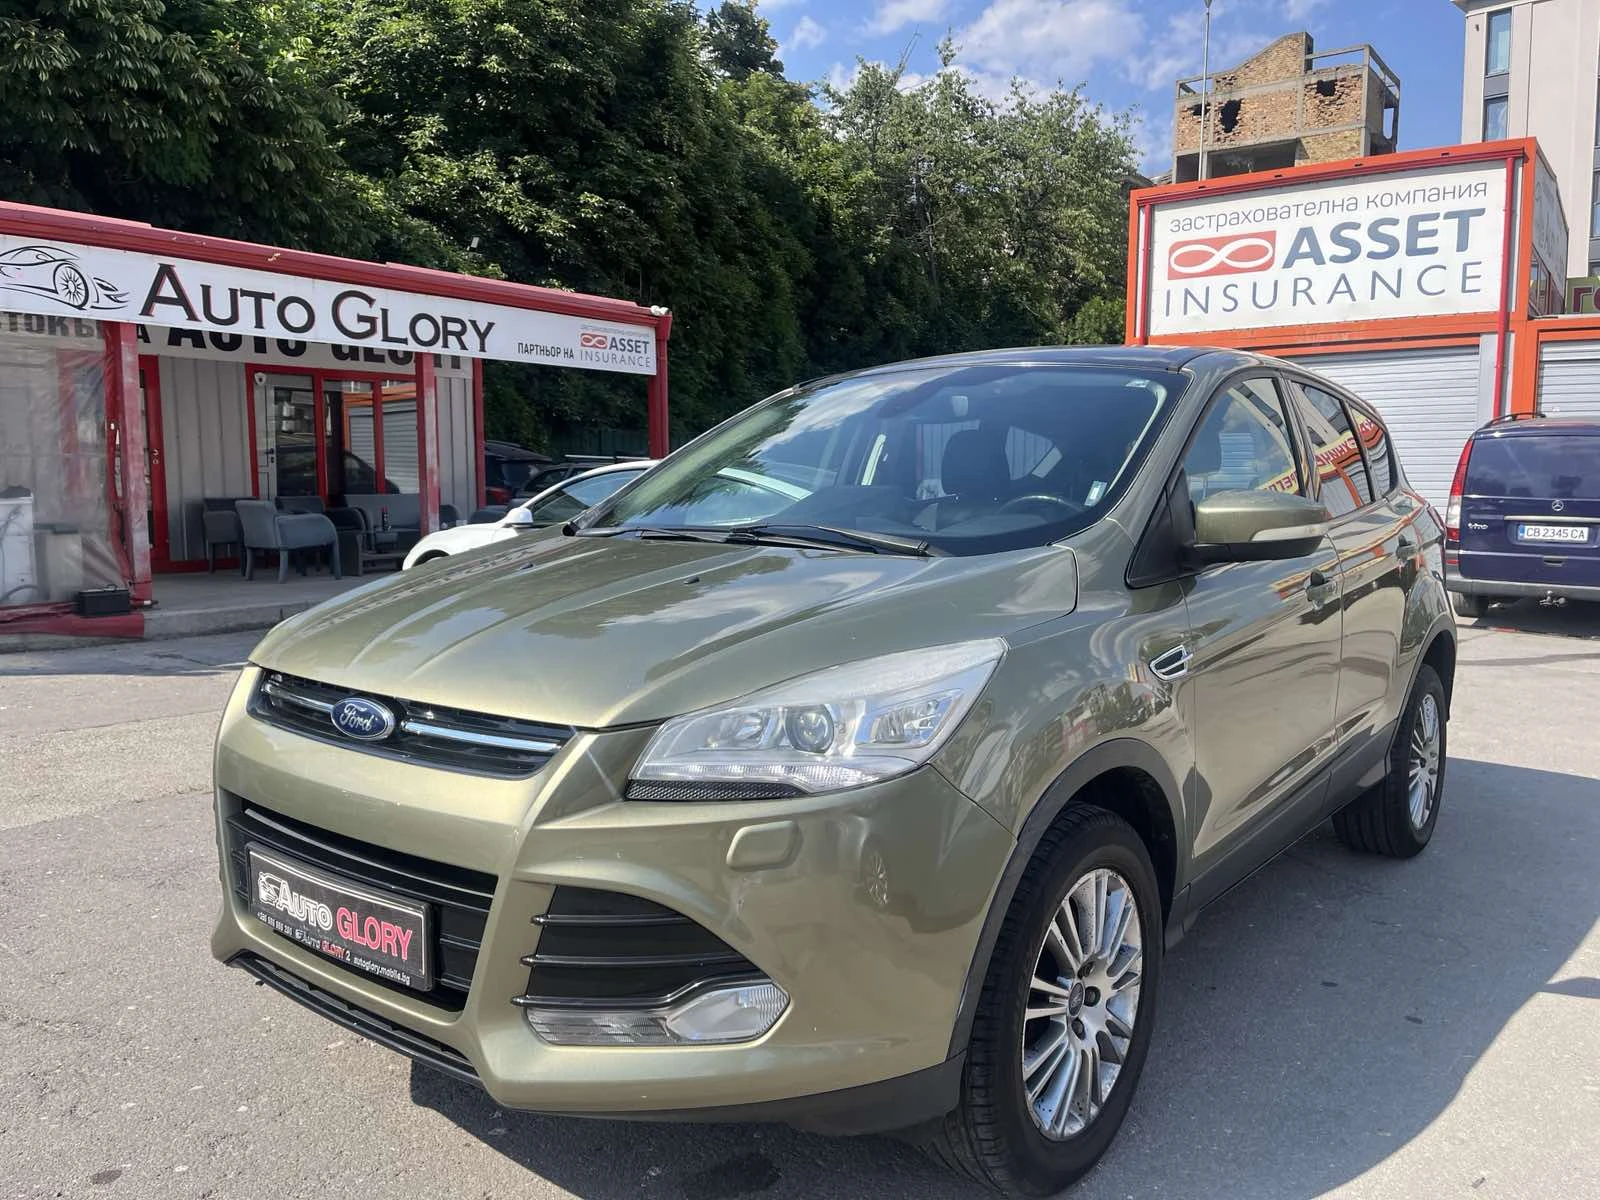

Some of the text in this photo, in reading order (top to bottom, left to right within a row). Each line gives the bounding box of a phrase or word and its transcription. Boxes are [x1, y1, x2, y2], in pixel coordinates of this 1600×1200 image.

[1169, 182, 1488, 233] застрахователна компания
[1282, 208, 1486, 269] ASSET
[1165, 261, 1483, 317] INSURANCE
[518, 342, 574, 360] ПАРТНЬОР НА
[580, 351, 651, 368] INSURANCE
[608, 337, 650, 354] ASSET
[1525, 527, 1585, 539] CB 2345 CA
[340, 703, 374, 731] Ford
[336, 907, 412, 960] GLORY
